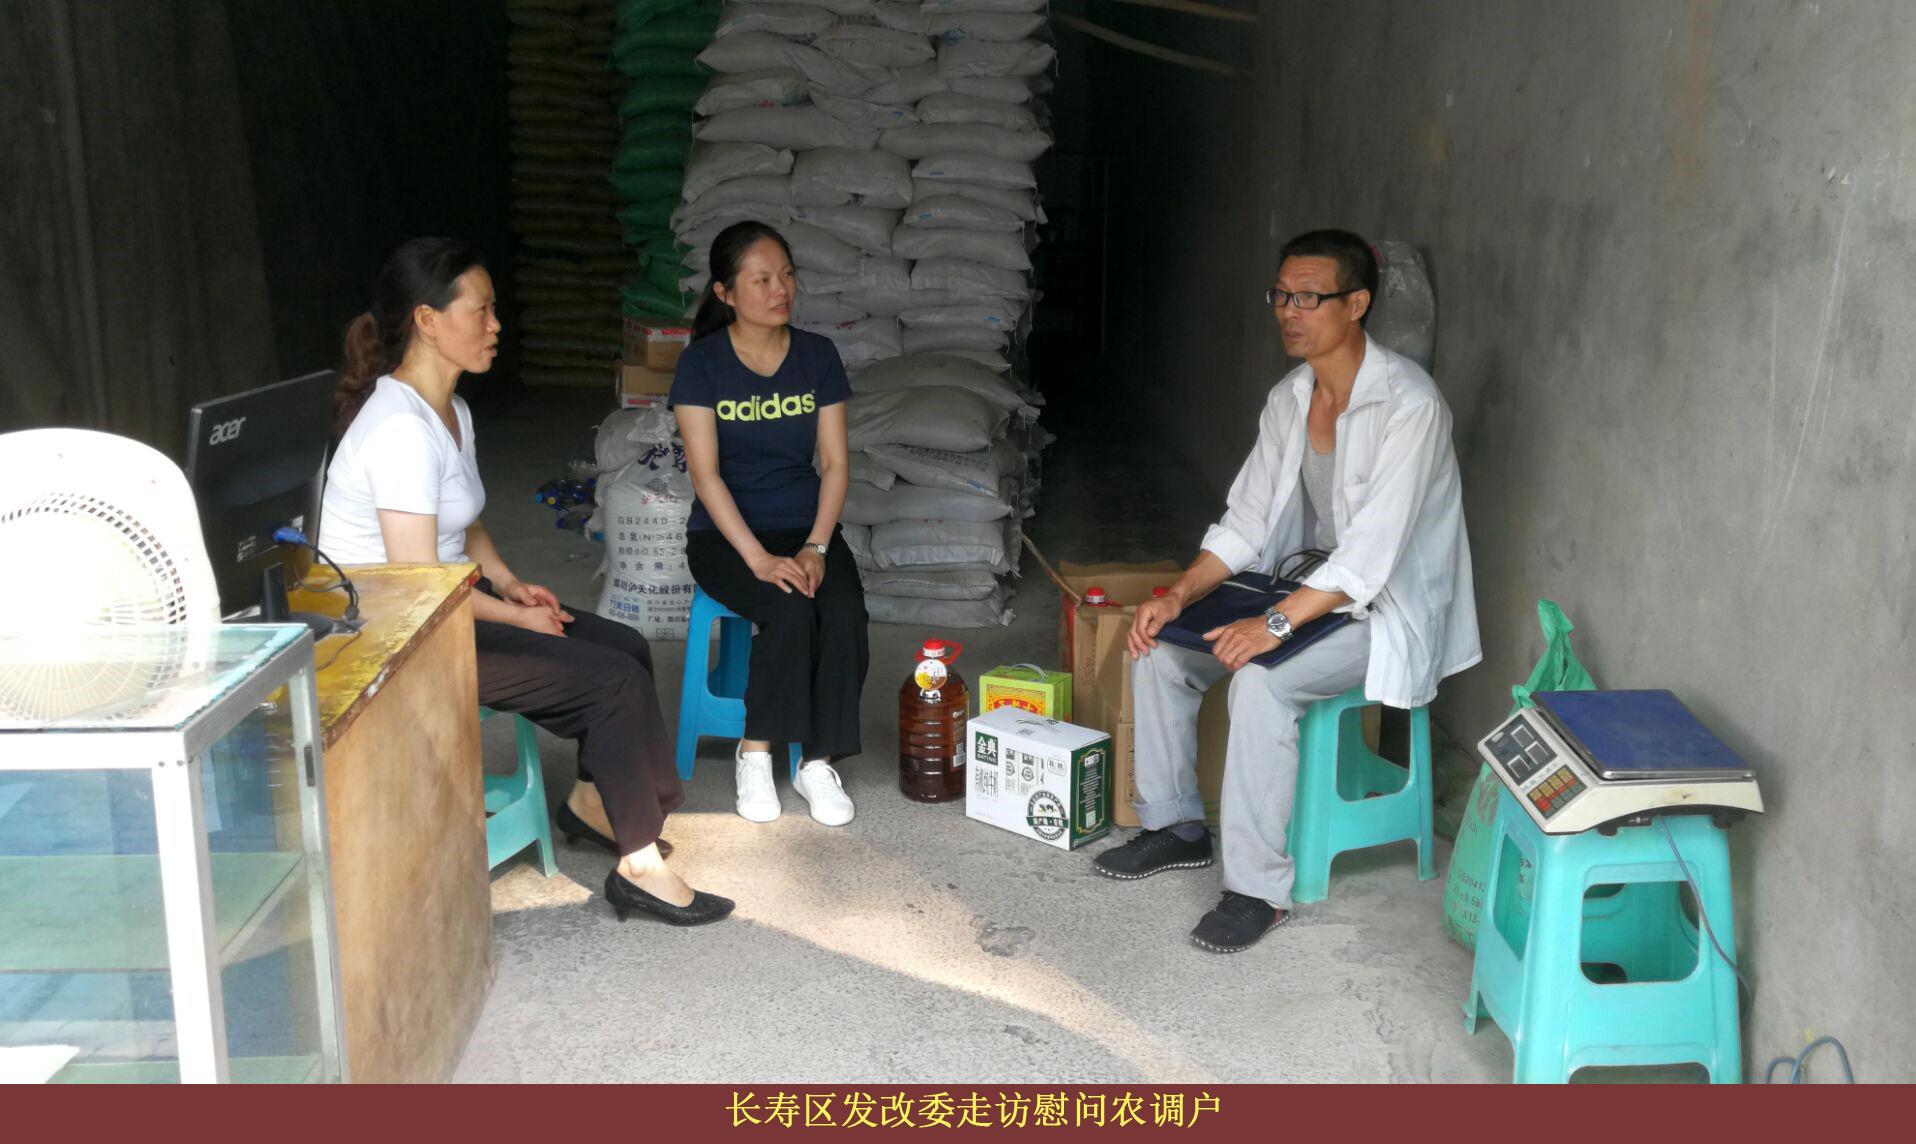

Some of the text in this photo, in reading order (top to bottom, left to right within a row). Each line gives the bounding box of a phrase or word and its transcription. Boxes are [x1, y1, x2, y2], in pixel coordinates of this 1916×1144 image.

[717, 393, 816, 421] adidas
[209, 416, 246, 445] acer
[614, 578, 696, 595] 四川泸天化股份有
[976, 735, 997, 758] 金典
